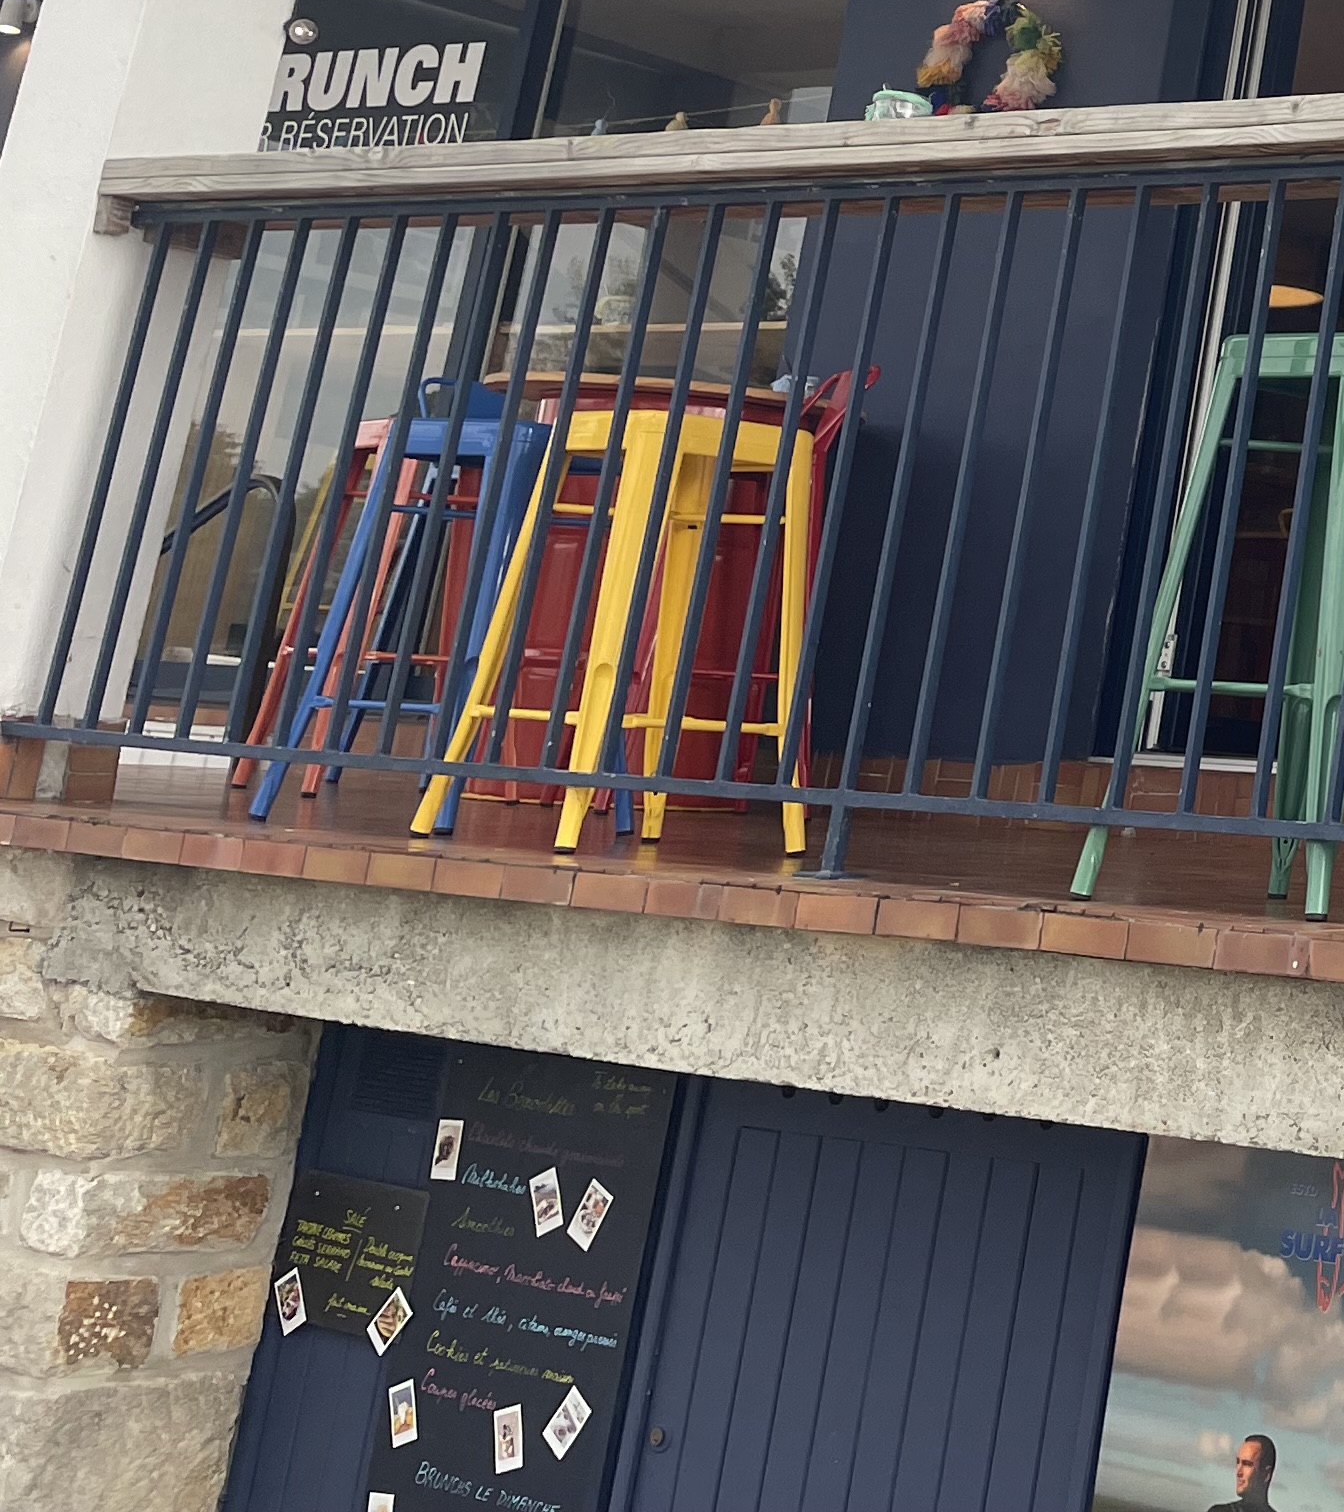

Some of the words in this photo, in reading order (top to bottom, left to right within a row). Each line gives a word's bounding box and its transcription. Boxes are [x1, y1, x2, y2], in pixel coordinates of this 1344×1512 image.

[266, 41, 487, 113] RUNCH
[278, 111, 470, 153] RÉSERVATION
[426, 1329, 470, 1363] Cookies
[473, 1347, 489, 1366] et
[474, 1485, 494, 1503] LE
